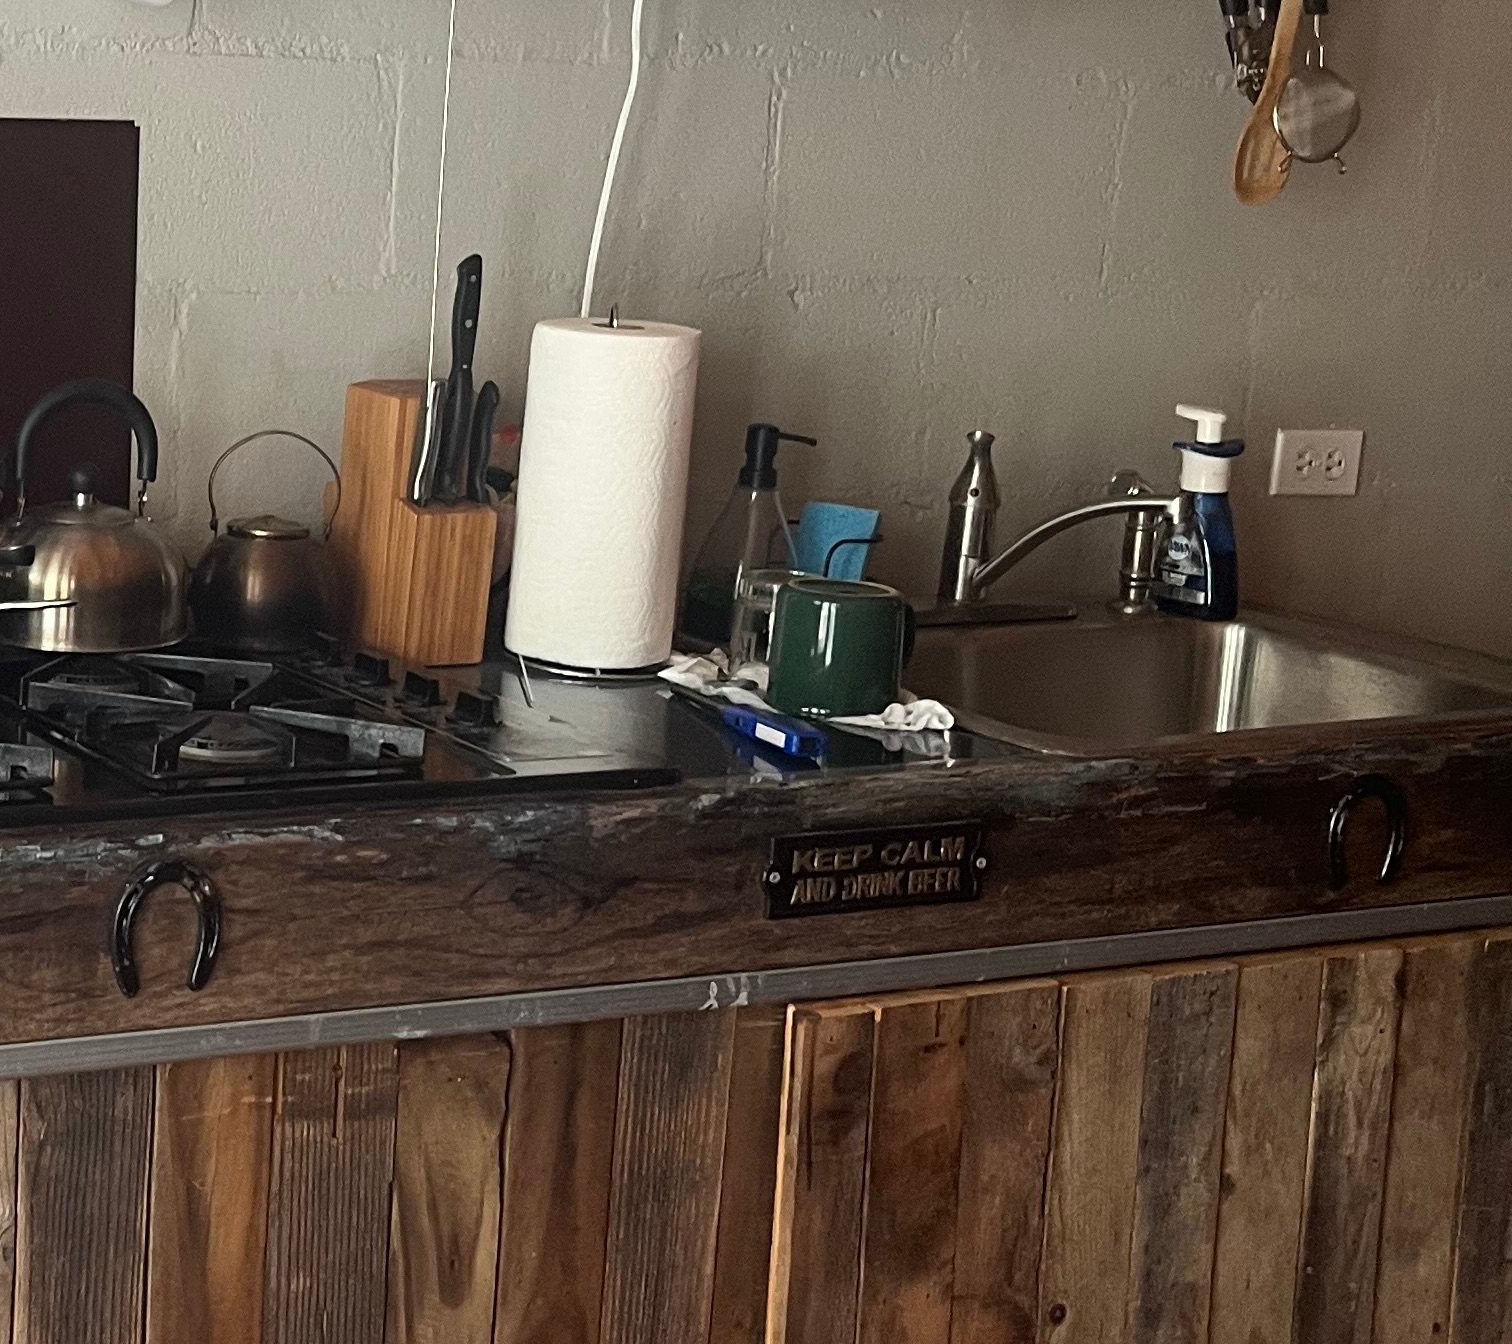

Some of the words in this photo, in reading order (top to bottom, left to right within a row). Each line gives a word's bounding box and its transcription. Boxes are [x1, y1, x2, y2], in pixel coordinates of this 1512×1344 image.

[791, 843, 873, 874] KEEP
[880, 836, 966, 866] CALM
[790, 877, 836, 905] AND
[841, 870, 906, 901] DRINK
[907, 866, 961, 895] BEER
